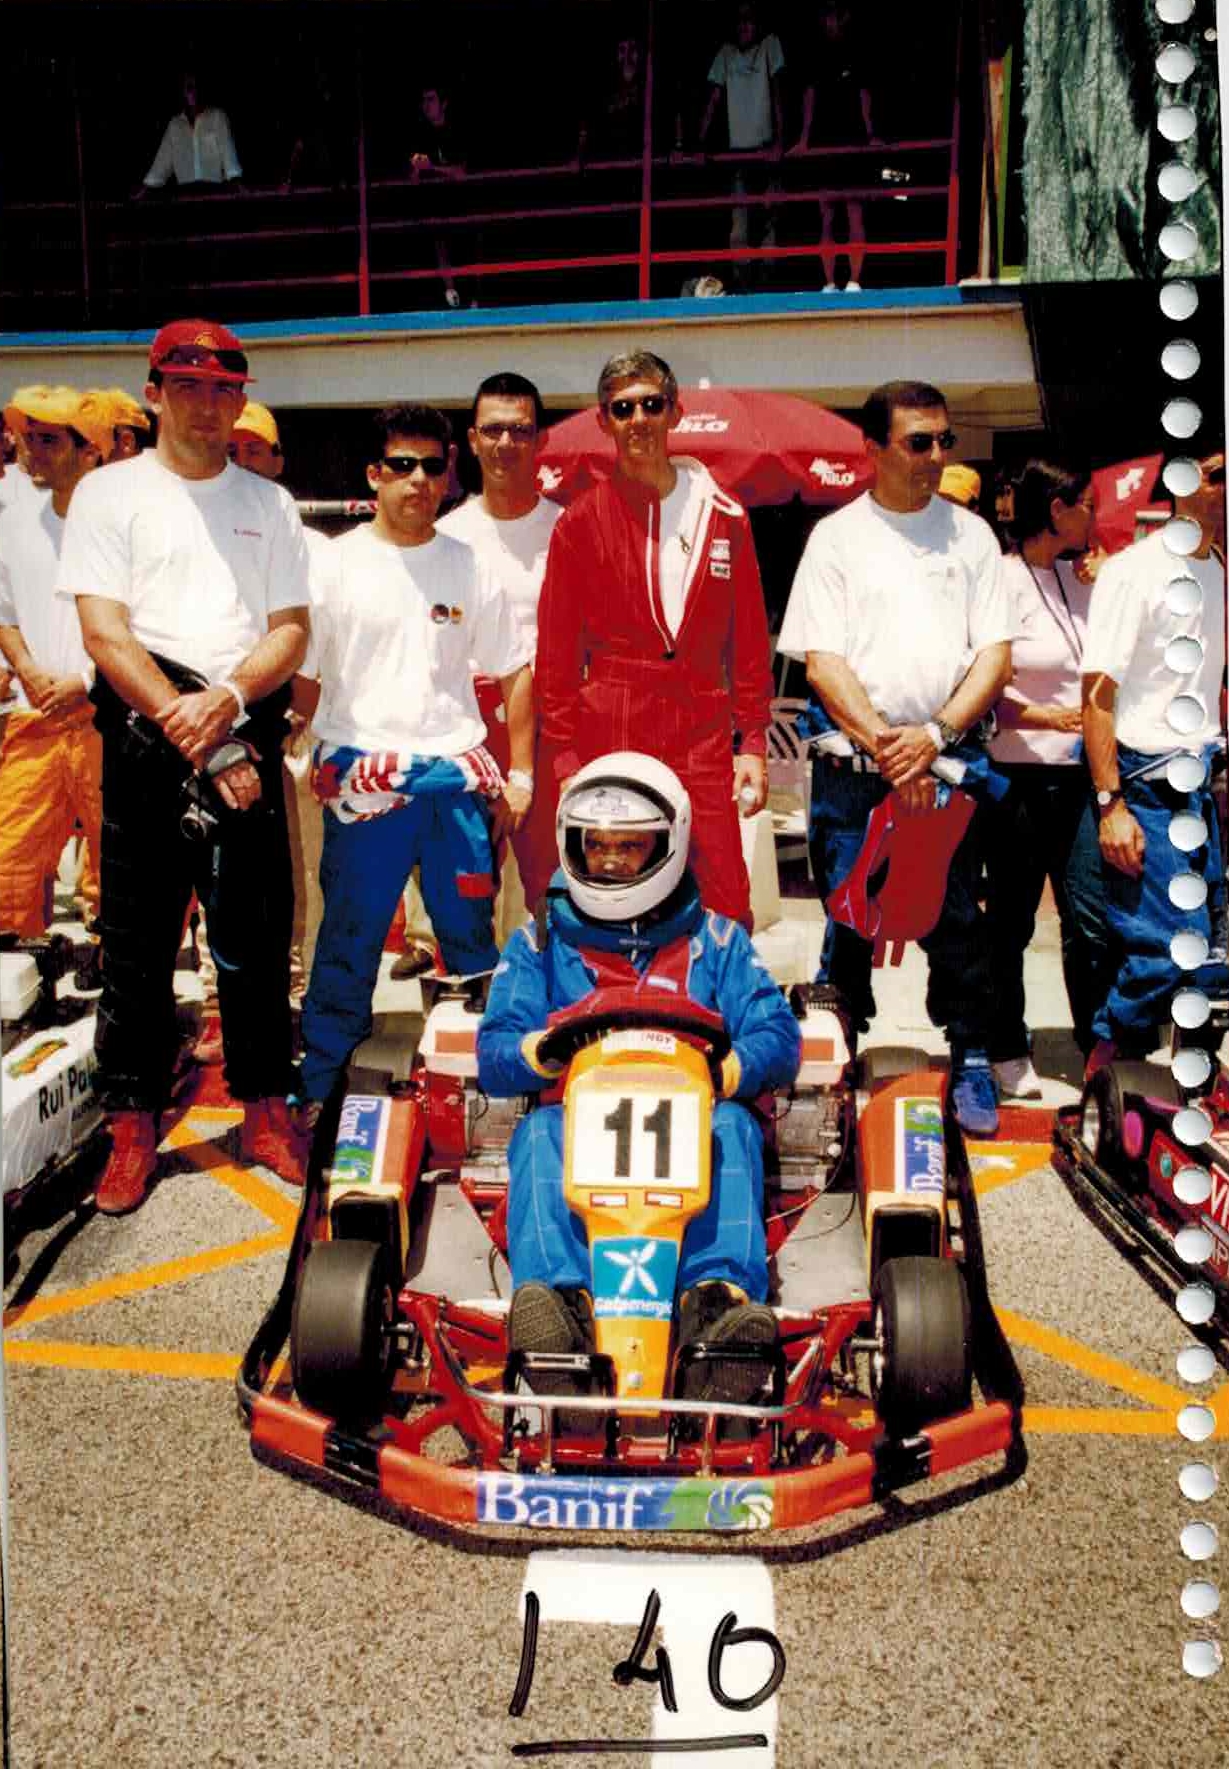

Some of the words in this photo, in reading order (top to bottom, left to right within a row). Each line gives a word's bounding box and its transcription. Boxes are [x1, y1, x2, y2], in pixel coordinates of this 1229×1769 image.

[39, 1072, 65, 1124] Rui
[603, 1097, 672, 1179] 11
[477, 1473, 652, 1530] Banif
[508, 1588, 787, 1717] 140
